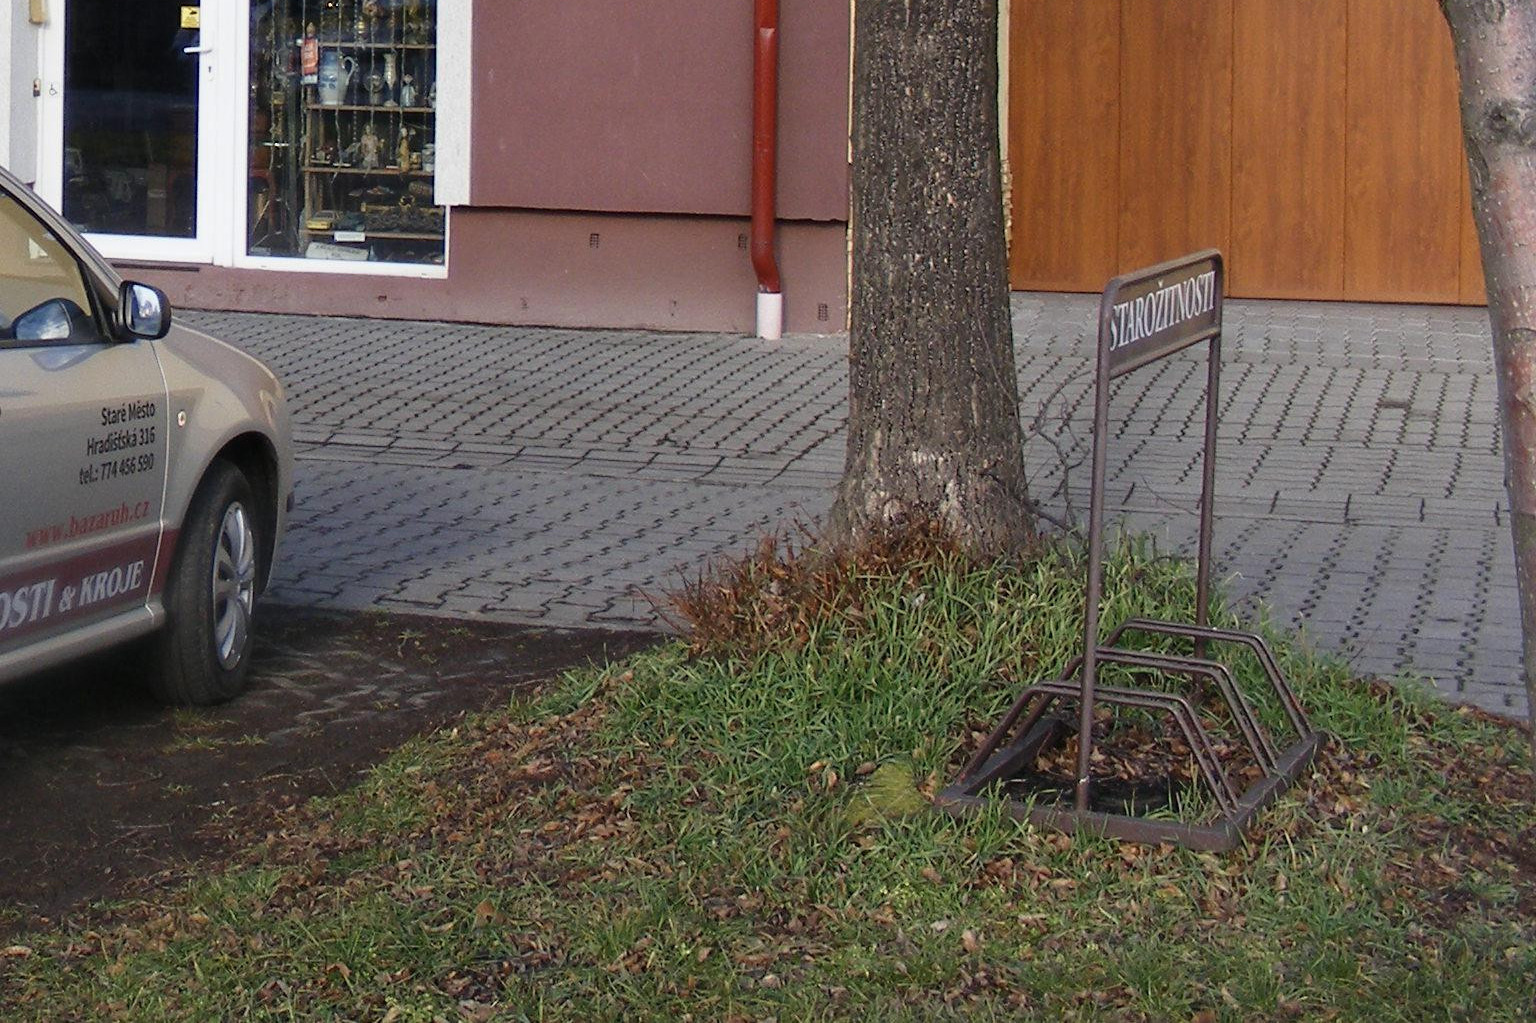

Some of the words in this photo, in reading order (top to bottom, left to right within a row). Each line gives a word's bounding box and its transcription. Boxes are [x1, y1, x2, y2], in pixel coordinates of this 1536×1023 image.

[1110, 271, 1216, 351] STAROŽITNOSTI
[101, 402, 126, 426] Staré
[128, 400, 156, 422] Město
[139, 426, 156, 446] 316
[101, 460, 117, 481] 774
[119, 456, 136, 477] 456
[137, 452, 155, 473] 590
[24, 501, 151, 551] www.bazaruh.cz
[58, 587, 78, 613] &
[78, 560, 145, 608] KROJE
